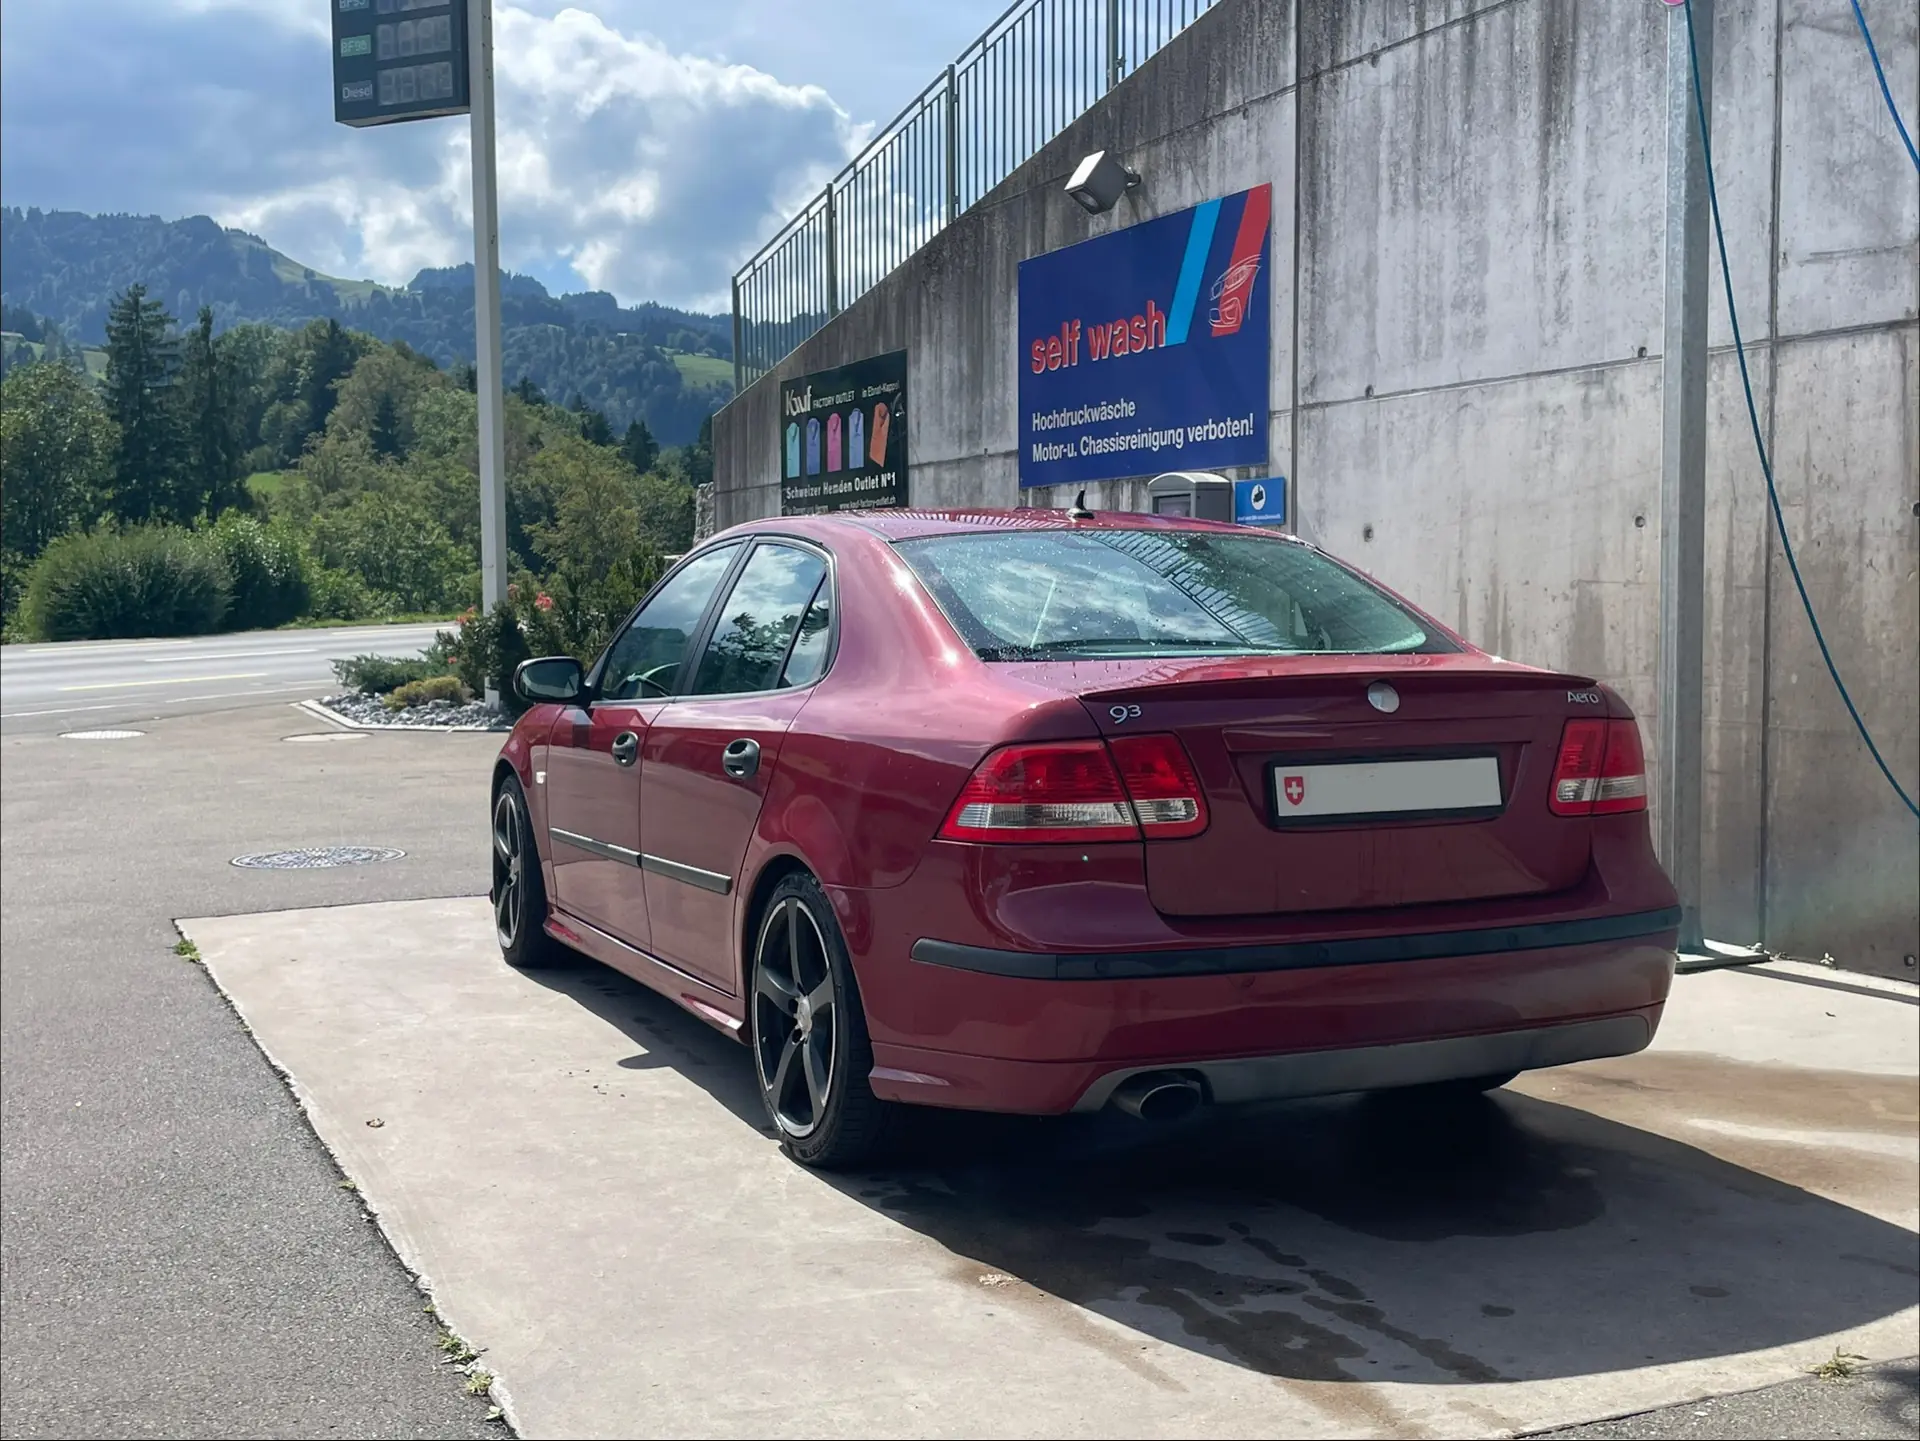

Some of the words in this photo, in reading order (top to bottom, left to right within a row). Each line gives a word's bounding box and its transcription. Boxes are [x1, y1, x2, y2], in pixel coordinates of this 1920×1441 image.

[342, 83, 373, 99] Diesel
[1031, 318, 1081, 374] self
[1087, 299, 1166, 361] wash
[812, 395, 835, 409] FACTORY
[835, 390, 855, 404] OUTLET
[1032, 398, 1136, 432] Hochdruckwäsche
[1032, 442, 1077, 463] Motor-u.
[1080, 427, 1184, 456] Chassisreinigung
[1187, 413, 1254, 442] verboten!
[786, 483, 821, 499] Schweizer
[822, 480, 853, 495] Hemden
[854, 474, 879, 491] Outlet
[1567, 690, 1599, 703] Aero
